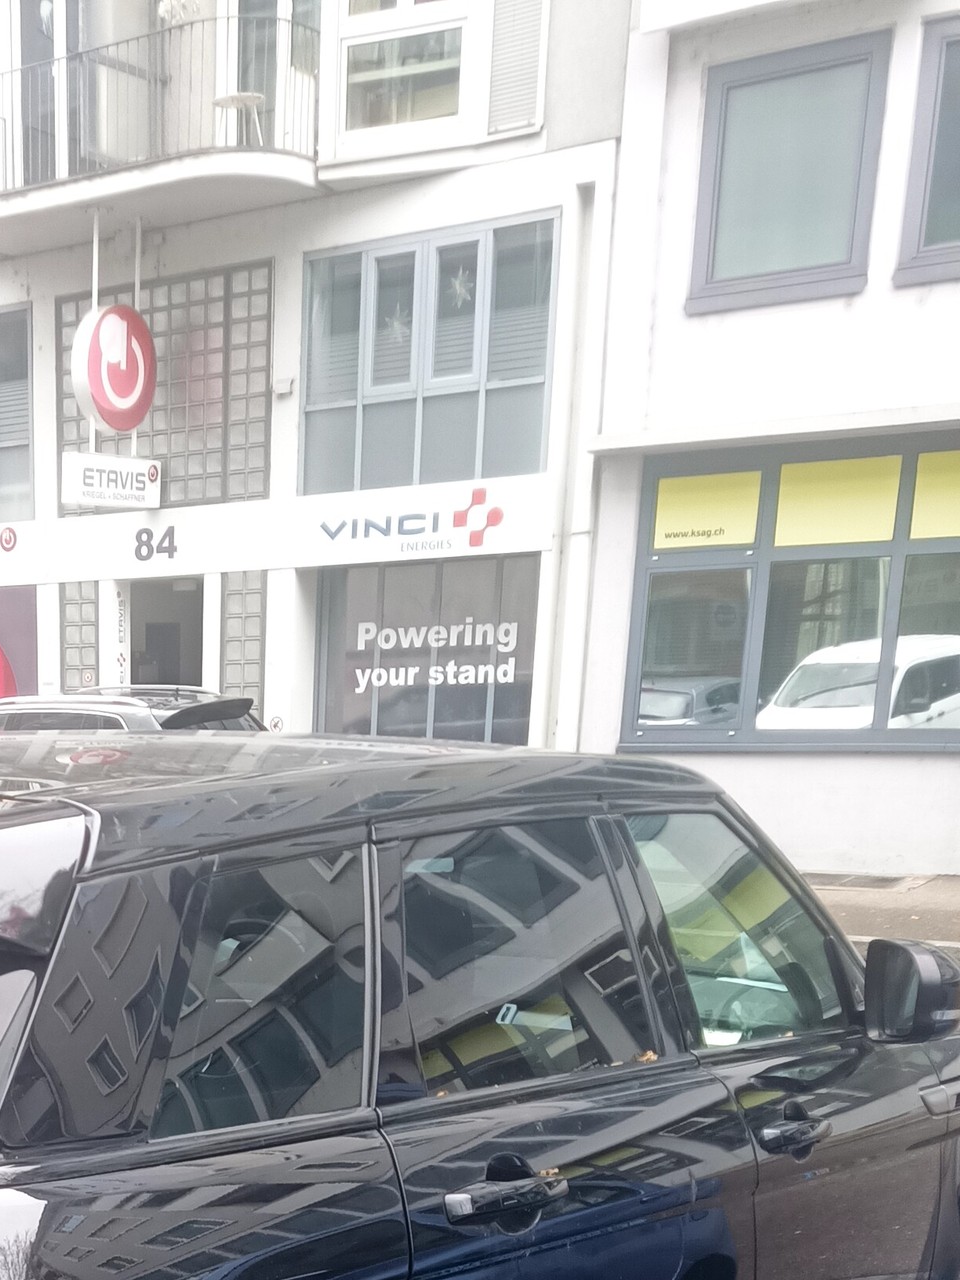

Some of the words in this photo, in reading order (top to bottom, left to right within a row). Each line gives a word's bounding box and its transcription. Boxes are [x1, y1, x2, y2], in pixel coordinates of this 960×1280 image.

[83, 467, 146, 491] ETAVIS
[83, 490, 107, 500] KRIEGEL
[113, 492, 145, 503] SCHAFFNER
[320, 512, 440, 540] VINCI
[664, 527, 725, 539] www.ksag.ch
[134, 525, 178, 561] 84
[401, 539, 452, 552] ENERGIES
[357, 616, 518, 652] Powering
[355, 666, 420, 694] your
[428, 657, 516, 685] stand
